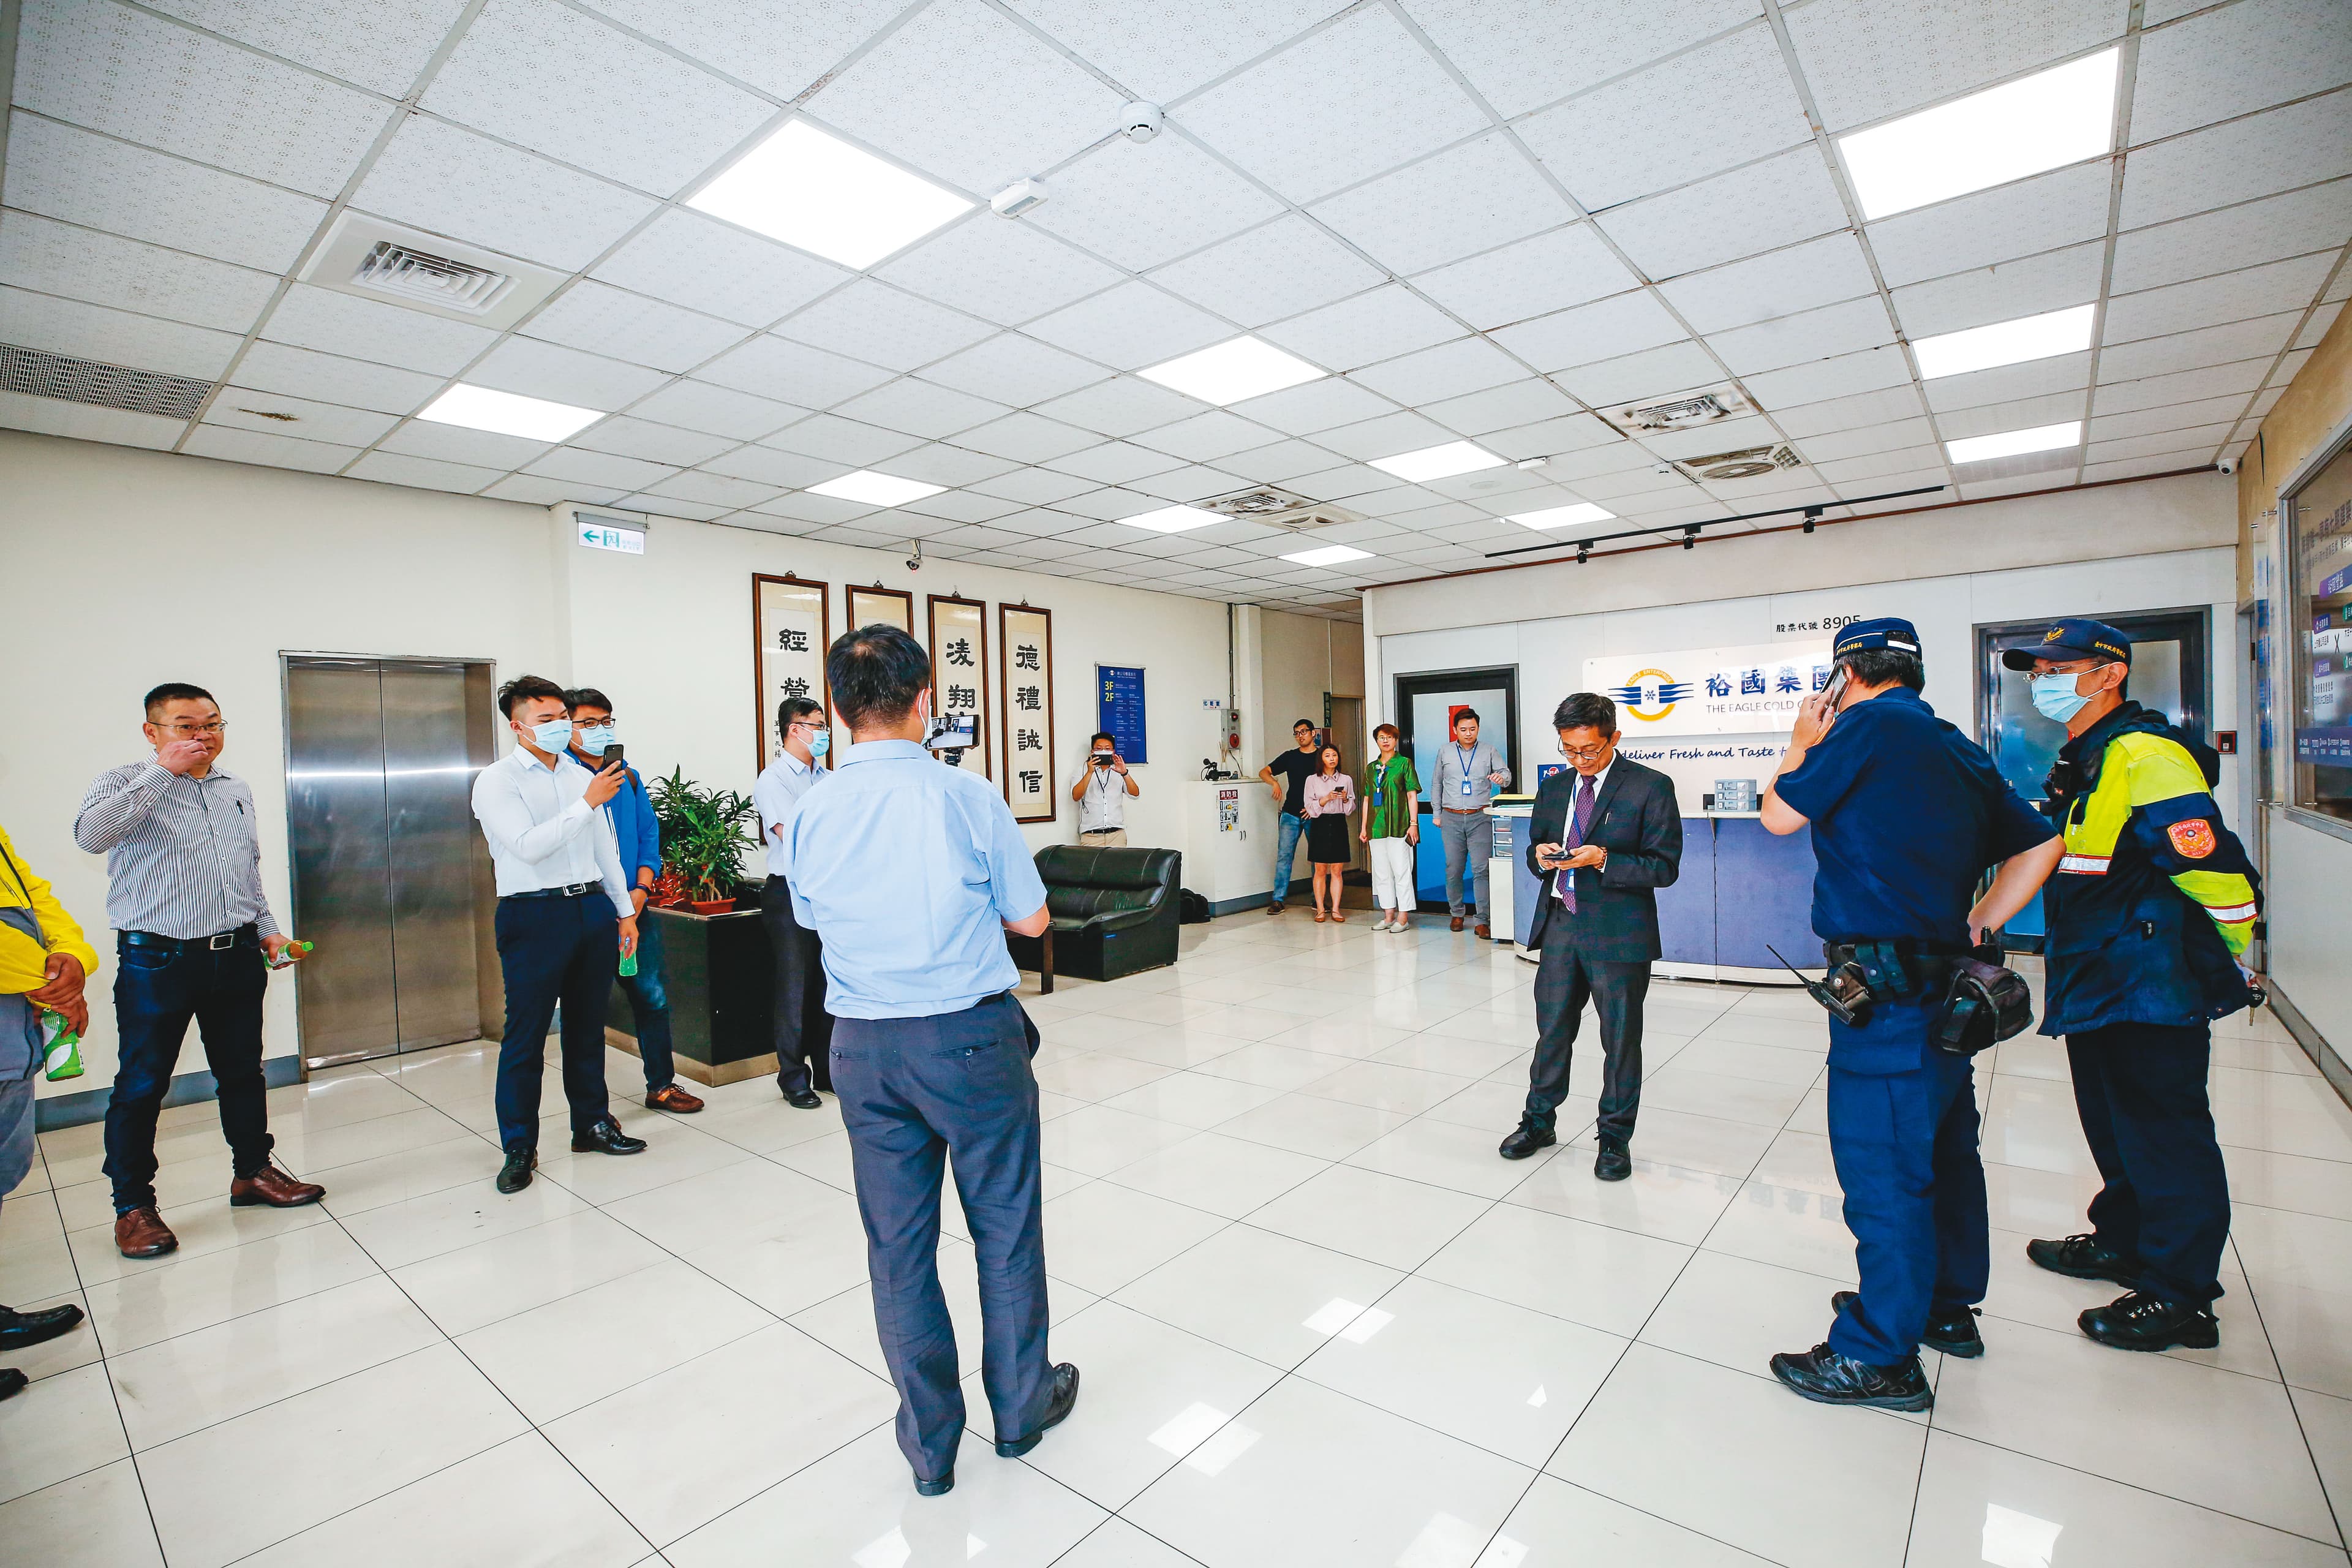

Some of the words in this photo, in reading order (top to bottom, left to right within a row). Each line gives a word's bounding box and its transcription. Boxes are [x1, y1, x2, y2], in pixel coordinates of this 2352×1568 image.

[1776, 622, 1818, 633] 股票代號
[1627, 671, 1642, 685] EAGLE
[1643, 669, 1673, 683] ENTERPRISE
[1104, 681, 1114, 690] 3F
[1105, 693, 1114, 702] 2F
[1706, 704, 1725, 714] THE
[1729, 703, 1762, 712] EAGLE
[1764, 701, 1795, 710] COLD
[1016, 644, 1043, 793] 德禮誠信
[1621, 750, 1665, 760] deliver
[1670, 748, 1704, 759] Fresh
[1707, 748, 1734, 757] and
[1738, 747, 1775, 757] Taste
